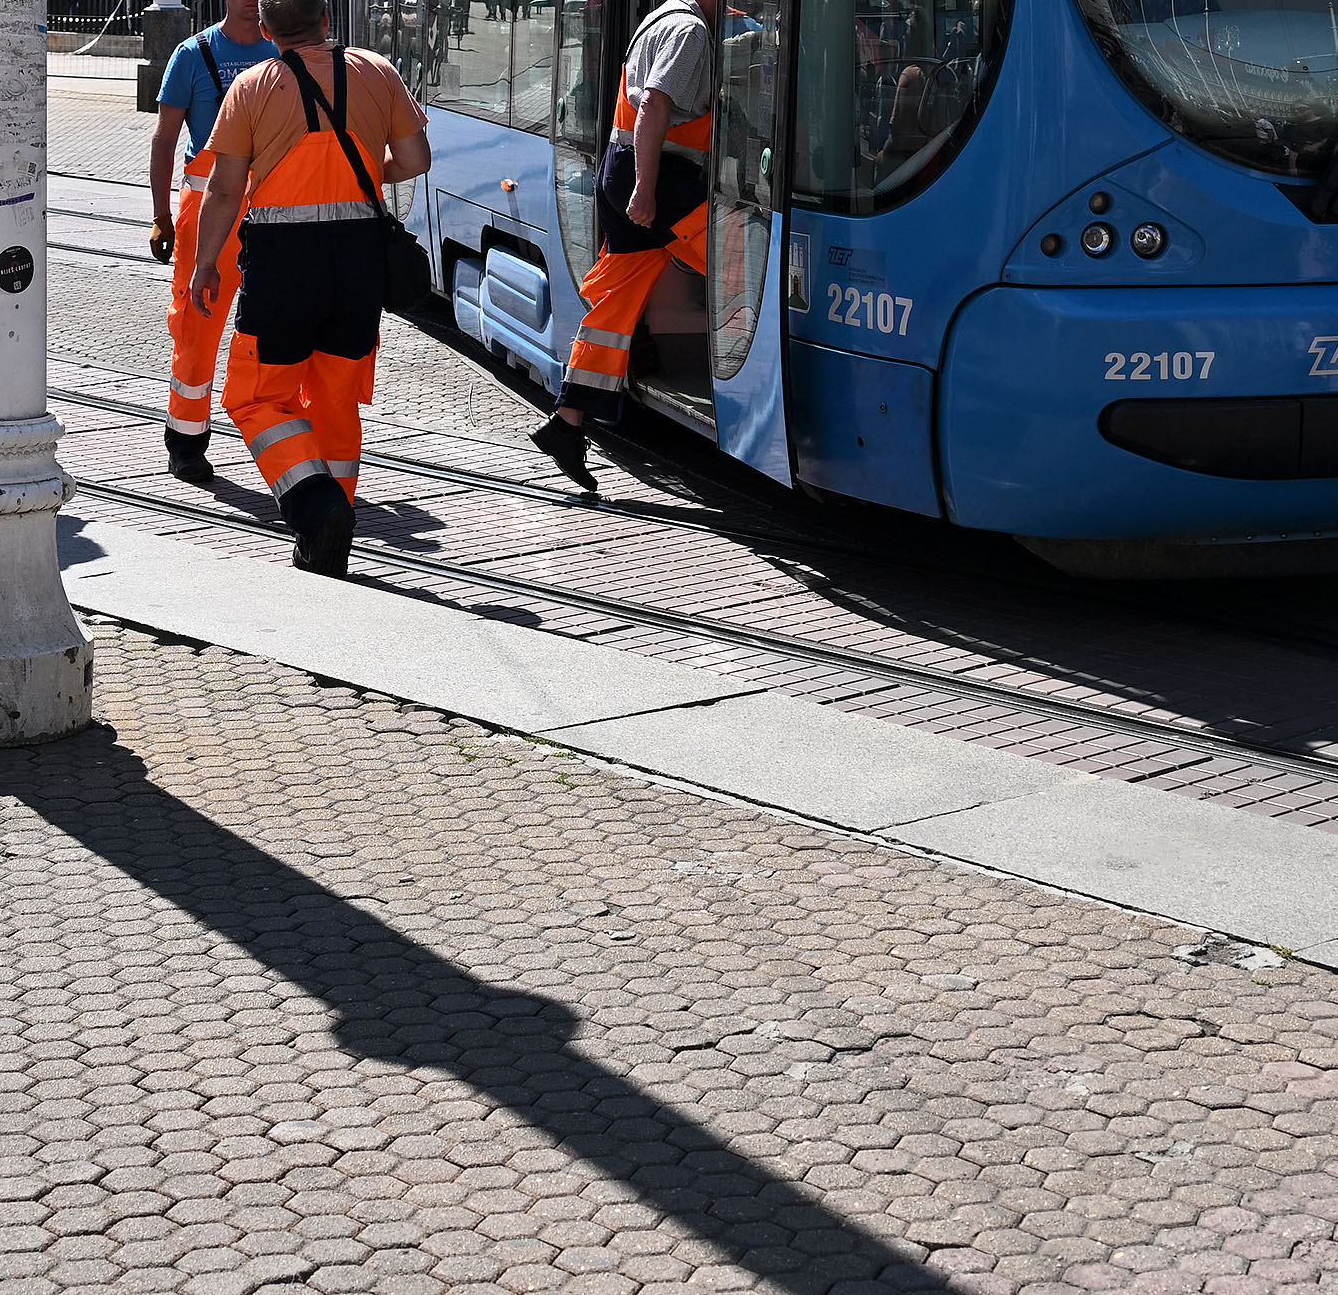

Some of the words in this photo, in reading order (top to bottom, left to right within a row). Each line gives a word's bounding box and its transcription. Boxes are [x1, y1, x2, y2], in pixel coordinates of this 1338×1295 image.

[829, 246, 853, 266] ZET
[827, 283, 913, 336] 22107
[1104, 350, 1215, 382] 22107
